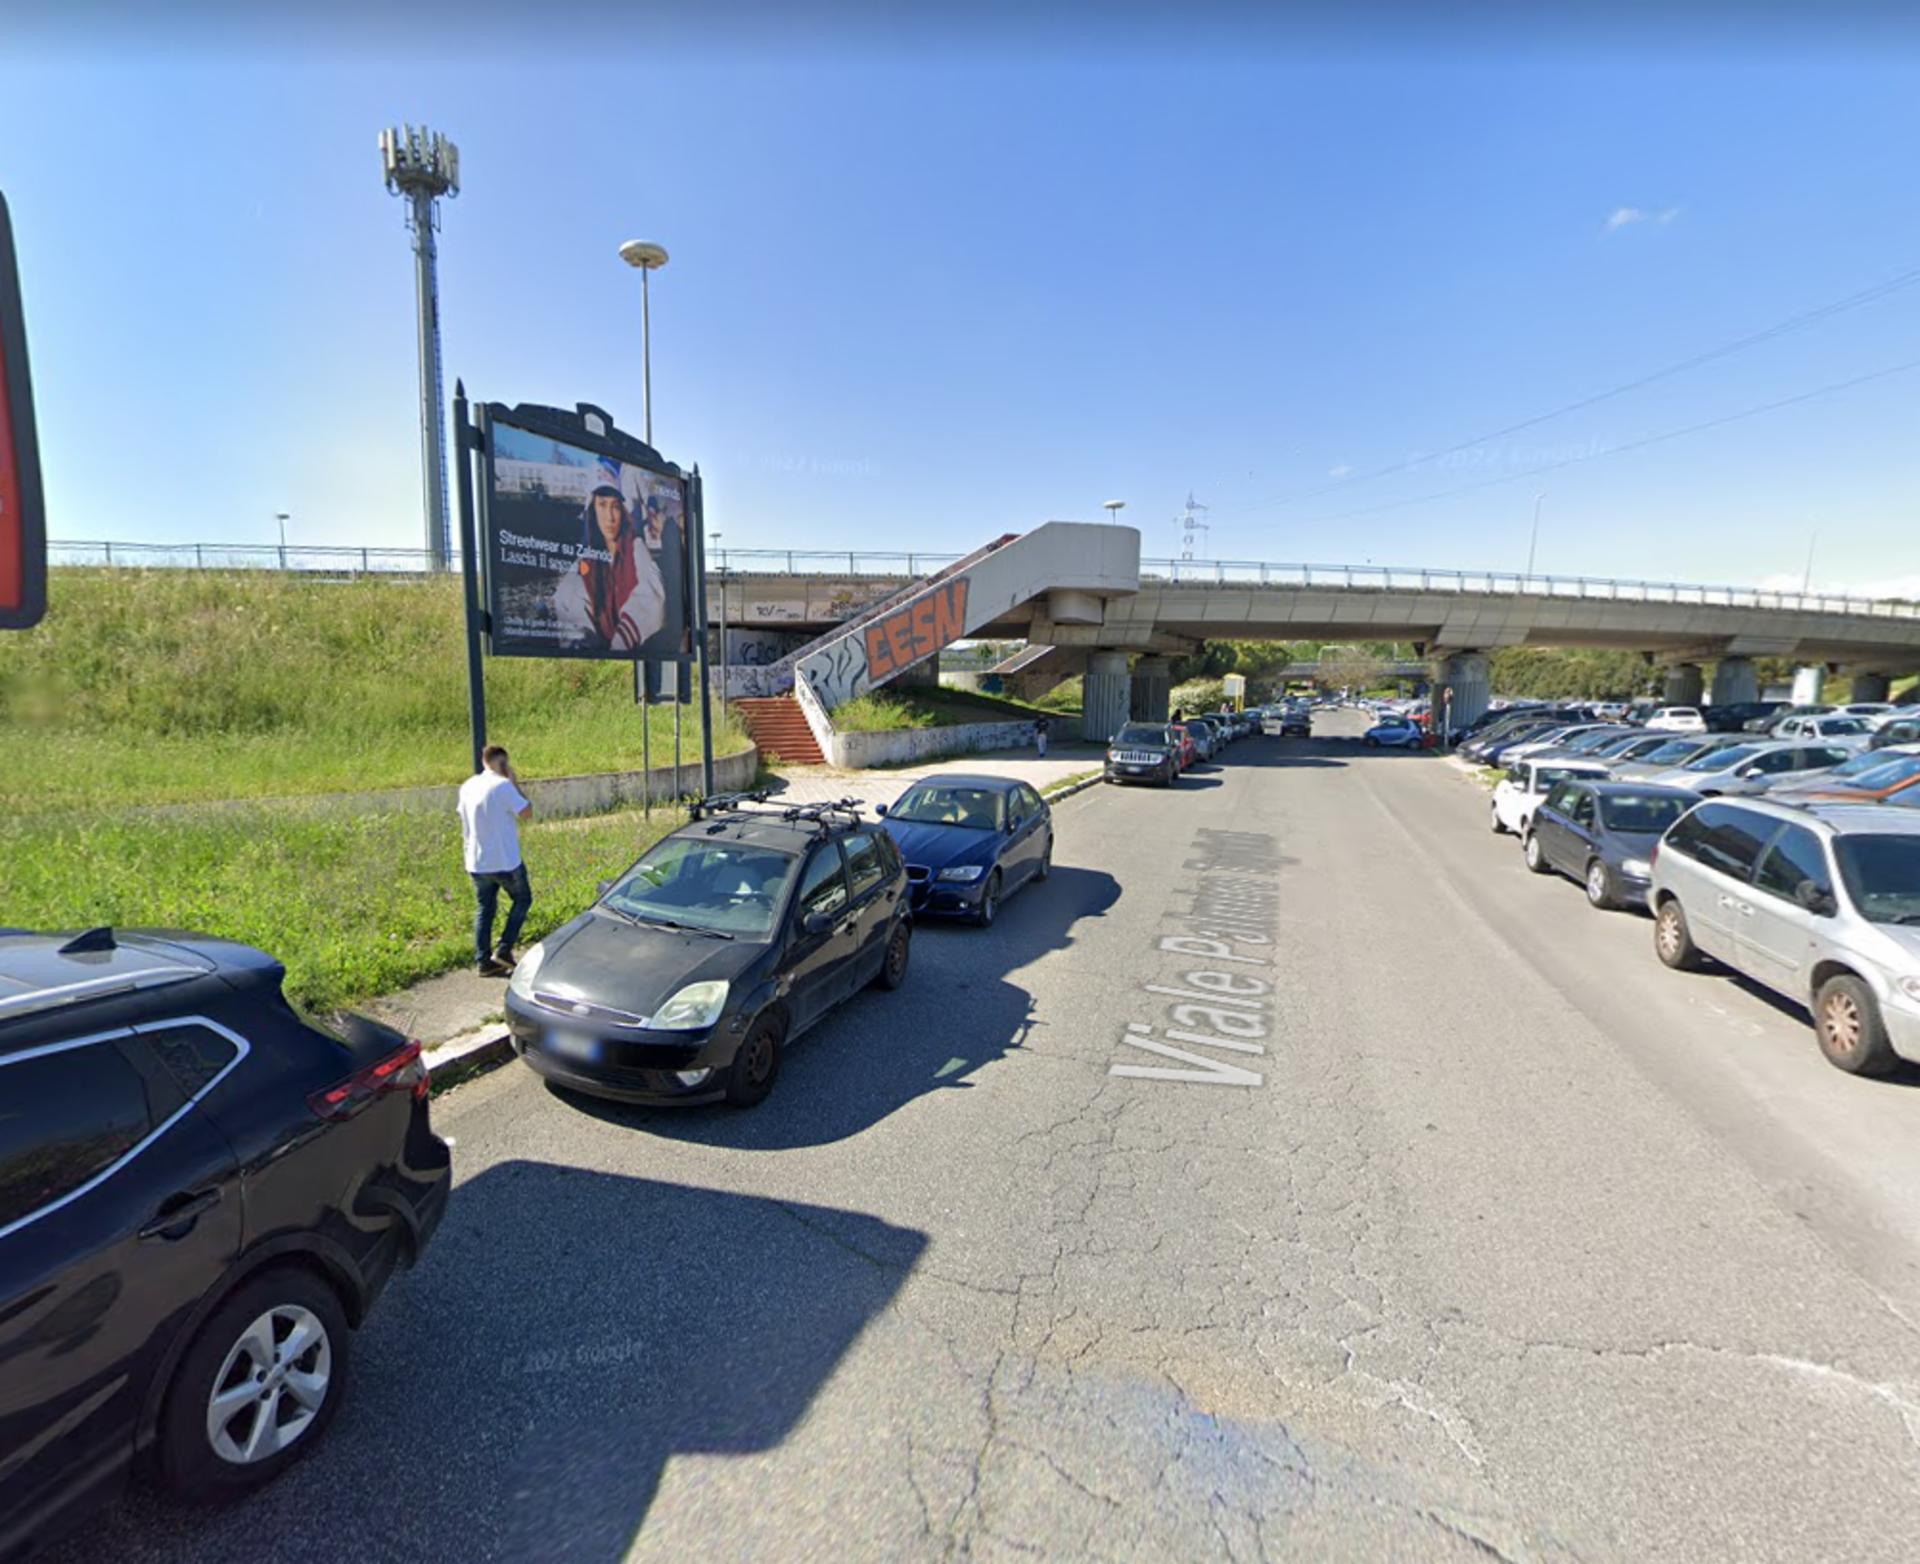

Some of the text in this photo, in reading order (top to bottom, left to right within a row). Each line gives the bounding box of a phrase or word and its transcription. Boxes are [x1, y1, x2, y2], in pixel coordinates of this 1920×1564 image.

[499, 529, 560, 553] Streetwear
[562, 544, 574, 556] su
[501, 547, 537, 566] Lascia
